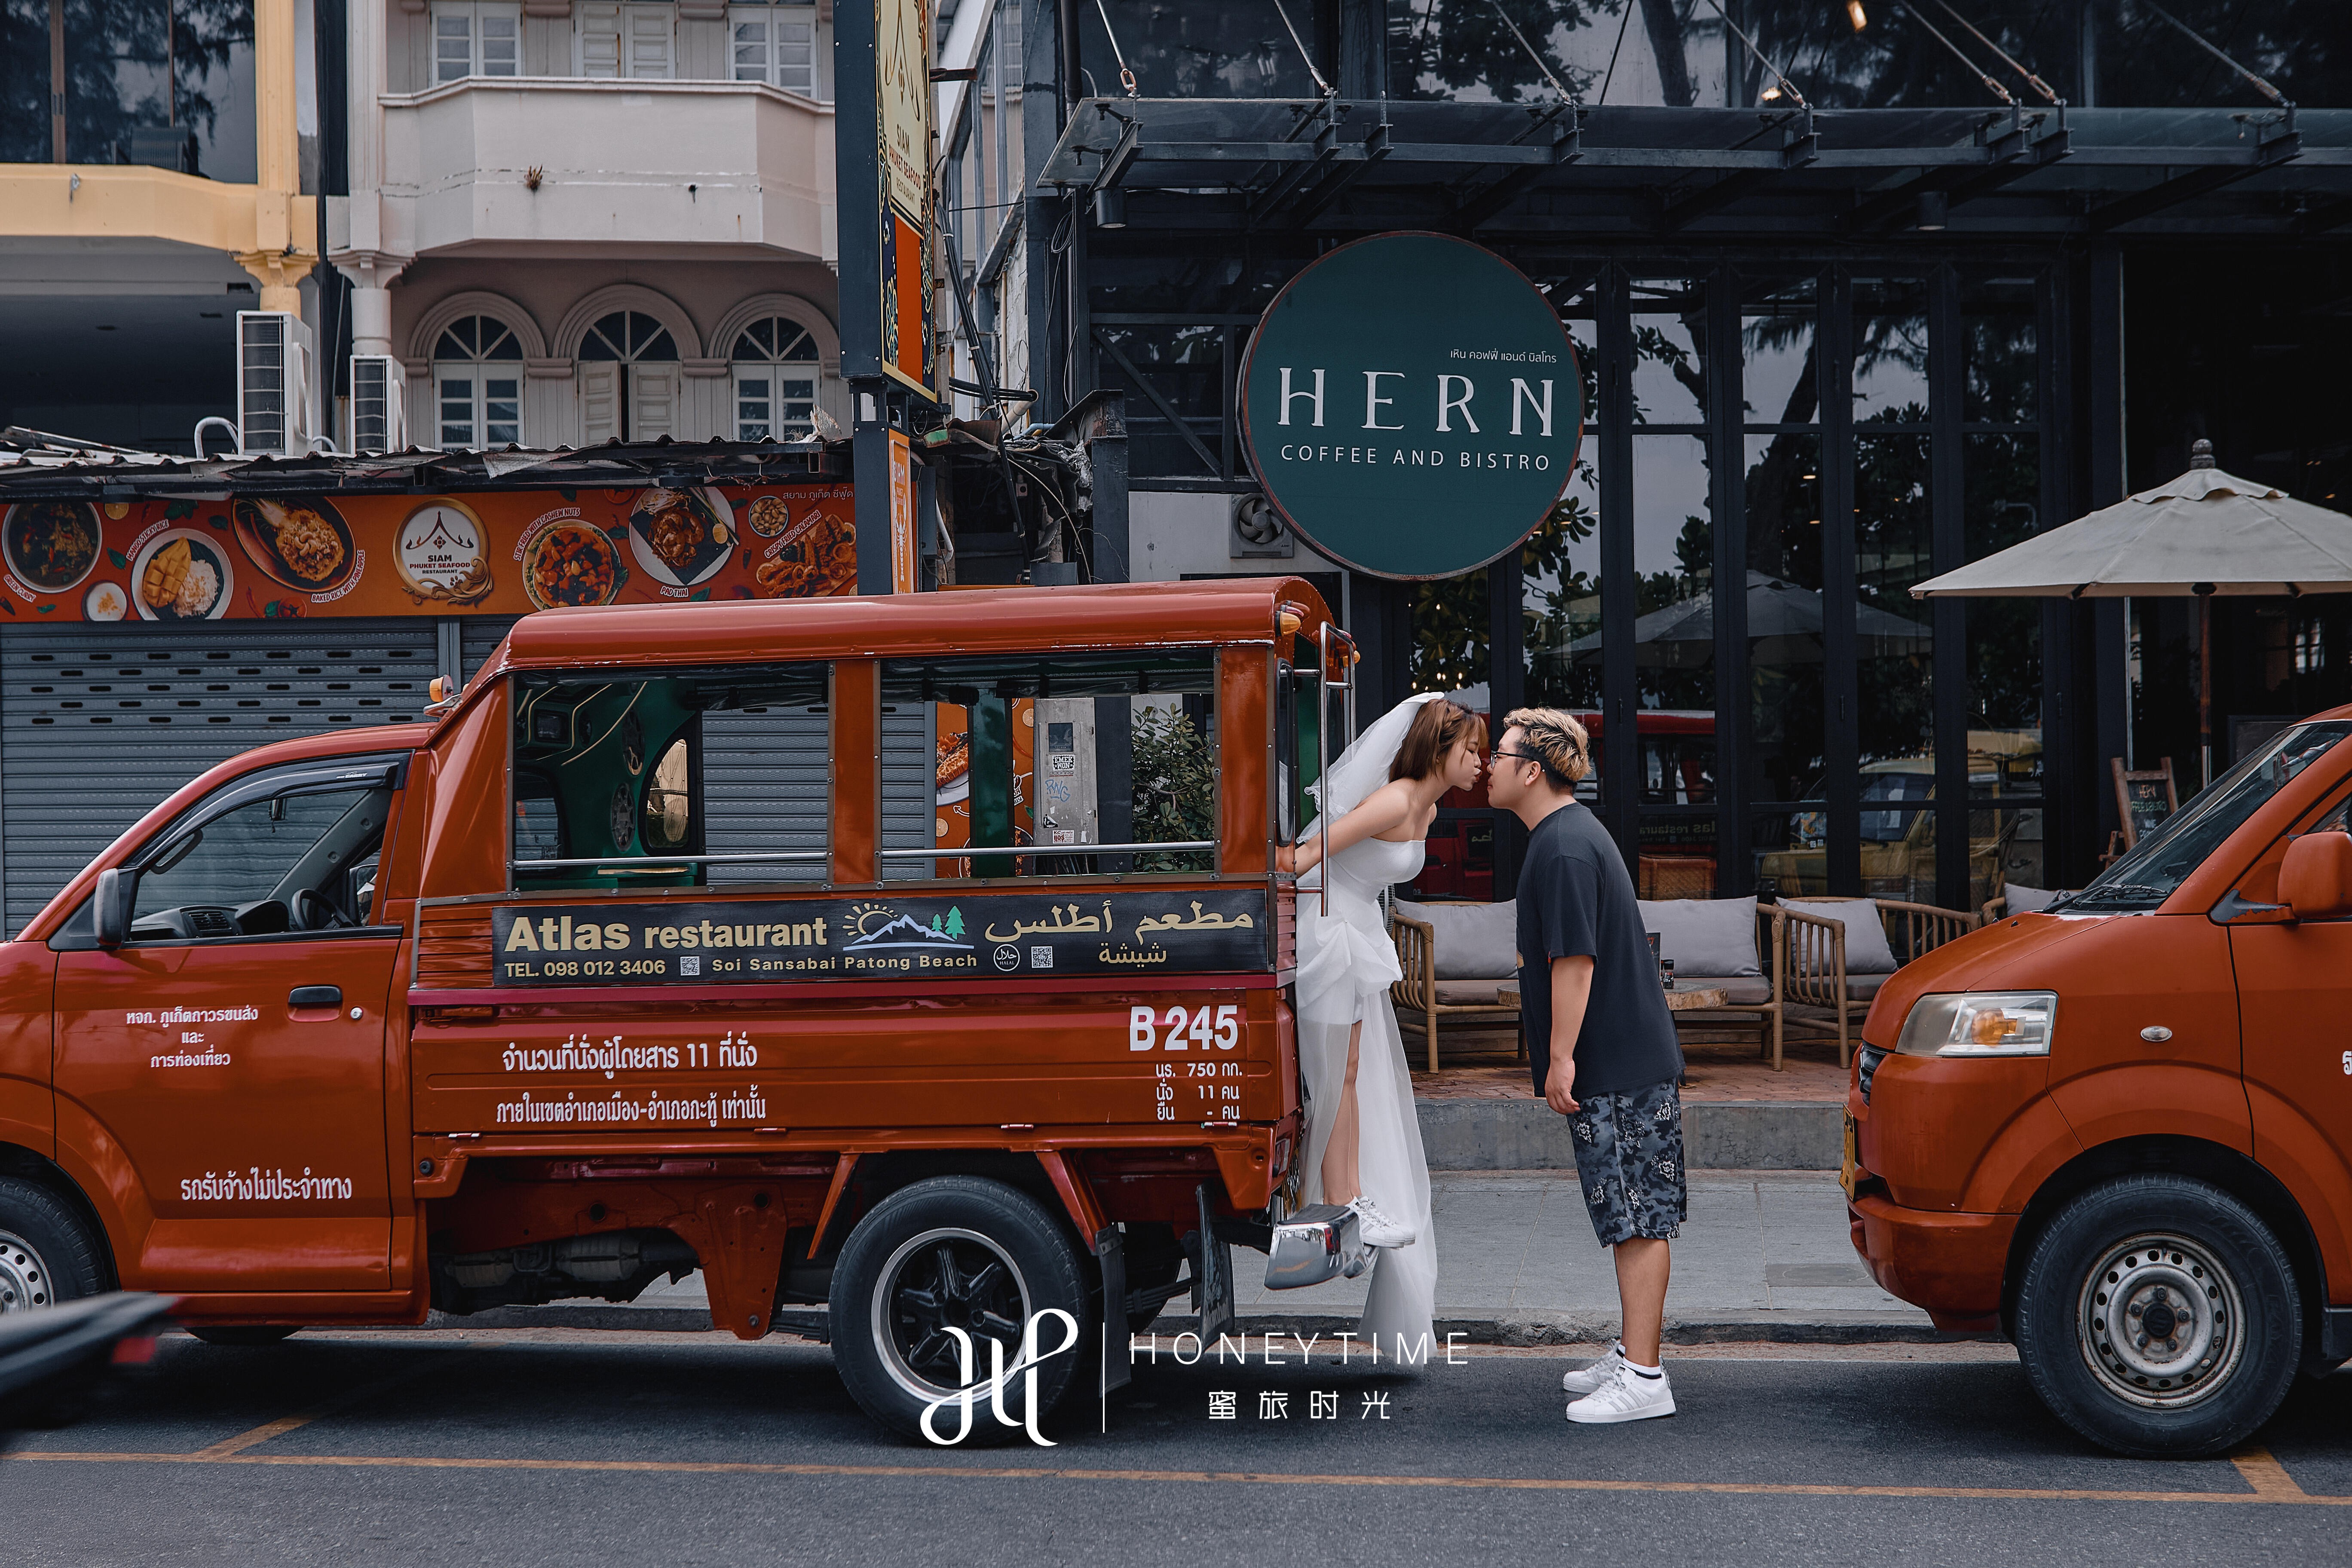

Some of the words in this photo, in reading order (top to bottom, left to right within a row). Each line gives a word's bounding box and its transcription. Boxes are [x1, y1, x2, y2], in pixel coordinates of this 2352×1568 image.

[897, 123, 910, 157] SIAM
[889, 144, 903, 173] PHUKET
[903, 159, 921, 190] SEAFOOD
[896, 177, 915, 205] RESTAURANT
[1450, 349, 1467, 359] เหิน
[1469, 348, 1498, 361] คอฟฟี่
[1501, 351, 1526, 362] แอนด์
[1528, 351, 1557, 364] บิสโทร
[1277, 368, 1553, 436] HERN
[1281, 445, 1377, 464] COFFEE
[1393, 449, 1444, 466] AND
[1461, 452, 1550, 471] BISTRO
[894, 460, 905, 486] SIAM
[809, 489, 830, 501] ภูเก็ต
[540, 508, 565, 524] CASHEW
[564, 507, 580, 516] NUTS
[527, 517, 543, 534] WITH
[765, 539, 783, 558] CRISPY
[780, 530, 797, 546] FRIED
[794, 509, 822, 535] CALAMARI
[126, 538, 142, 561] MANGO
[139, 524, 156, 543] STICKY
[155, 519, 169, 531] RICE
[518, 530, 531, 548] FRIED
[514, 545, 524, 561] STIR
[4, 574, 20, 593] GREEN
[17, 588, 36, 603] CURRY
[311, 593, 331, 603] BAKED
[330, 588, 344, 600] RICE
[342, 578, 357, 594] WITH
[352, 550, 365, 582] PINEAPPLE
[660, 586, 674, 597] PAD
[674, 588, 689, 597] THAI
[504, 916, 631, 952] Atlas
[645, 917, 827, 949] restaurant
[985, 899, 1113, 943] أطلس
[1135, 900, 1254, 945] مطعم
[712, 958, 741, 972] Soi
[750, 956, 836, 971] Sansabai
[844, 955, 911, 971] Patong
[919, 953, 977, 968] Beach
[996, 948, 1017, 961] حلال
[1099, 940, 1167, 968] شيشة
[504, 963, 540, 977] TEL.
[545, 962, 579, 977] 098
[584, 961, 615, 976] 012
[620, 960, 666, 975] 3406
[126, 1011, 156, 1025] หจก.
[160, 1004, 259, 1028] ภูเก็ตถาวรขนส่ง
[1130, 1006, 1156, 1051] B
[1164, 1005, 1238, 1051] 245
[181, 1031, 205, 1044] และ
[150, 1044, 231, 1068] การท่องเที่ยว
[502, 1033, 679, 1079] จำนวนที่นั่งผู้โดยสาร
[687, 1043, 709, 1068] 11
[720, 1031, 758, 1067] ที่นั่ง
[1187, 1063, 1216, 1078] 750
[1222, 1063, 1243, 1077] กก.
[1156, 1078, 1174, 1101] นั่ง
[1198, 1085, 1214, 1099] 11
[1222, 1085, 1240, 1100] คน
[496, 1090, 718, 1128] ภายในเขตอำเภอเมือง-อำเภอกะทู้
[722, 1084, 767, 1120] เท่านั้น
[1157, 1101, 1175, 1121] ยืน
[1222, 1106, 1240, 1120] คน
[181, 1167, 352, 1201] รถรับจ้างไม่ประจำทาง
